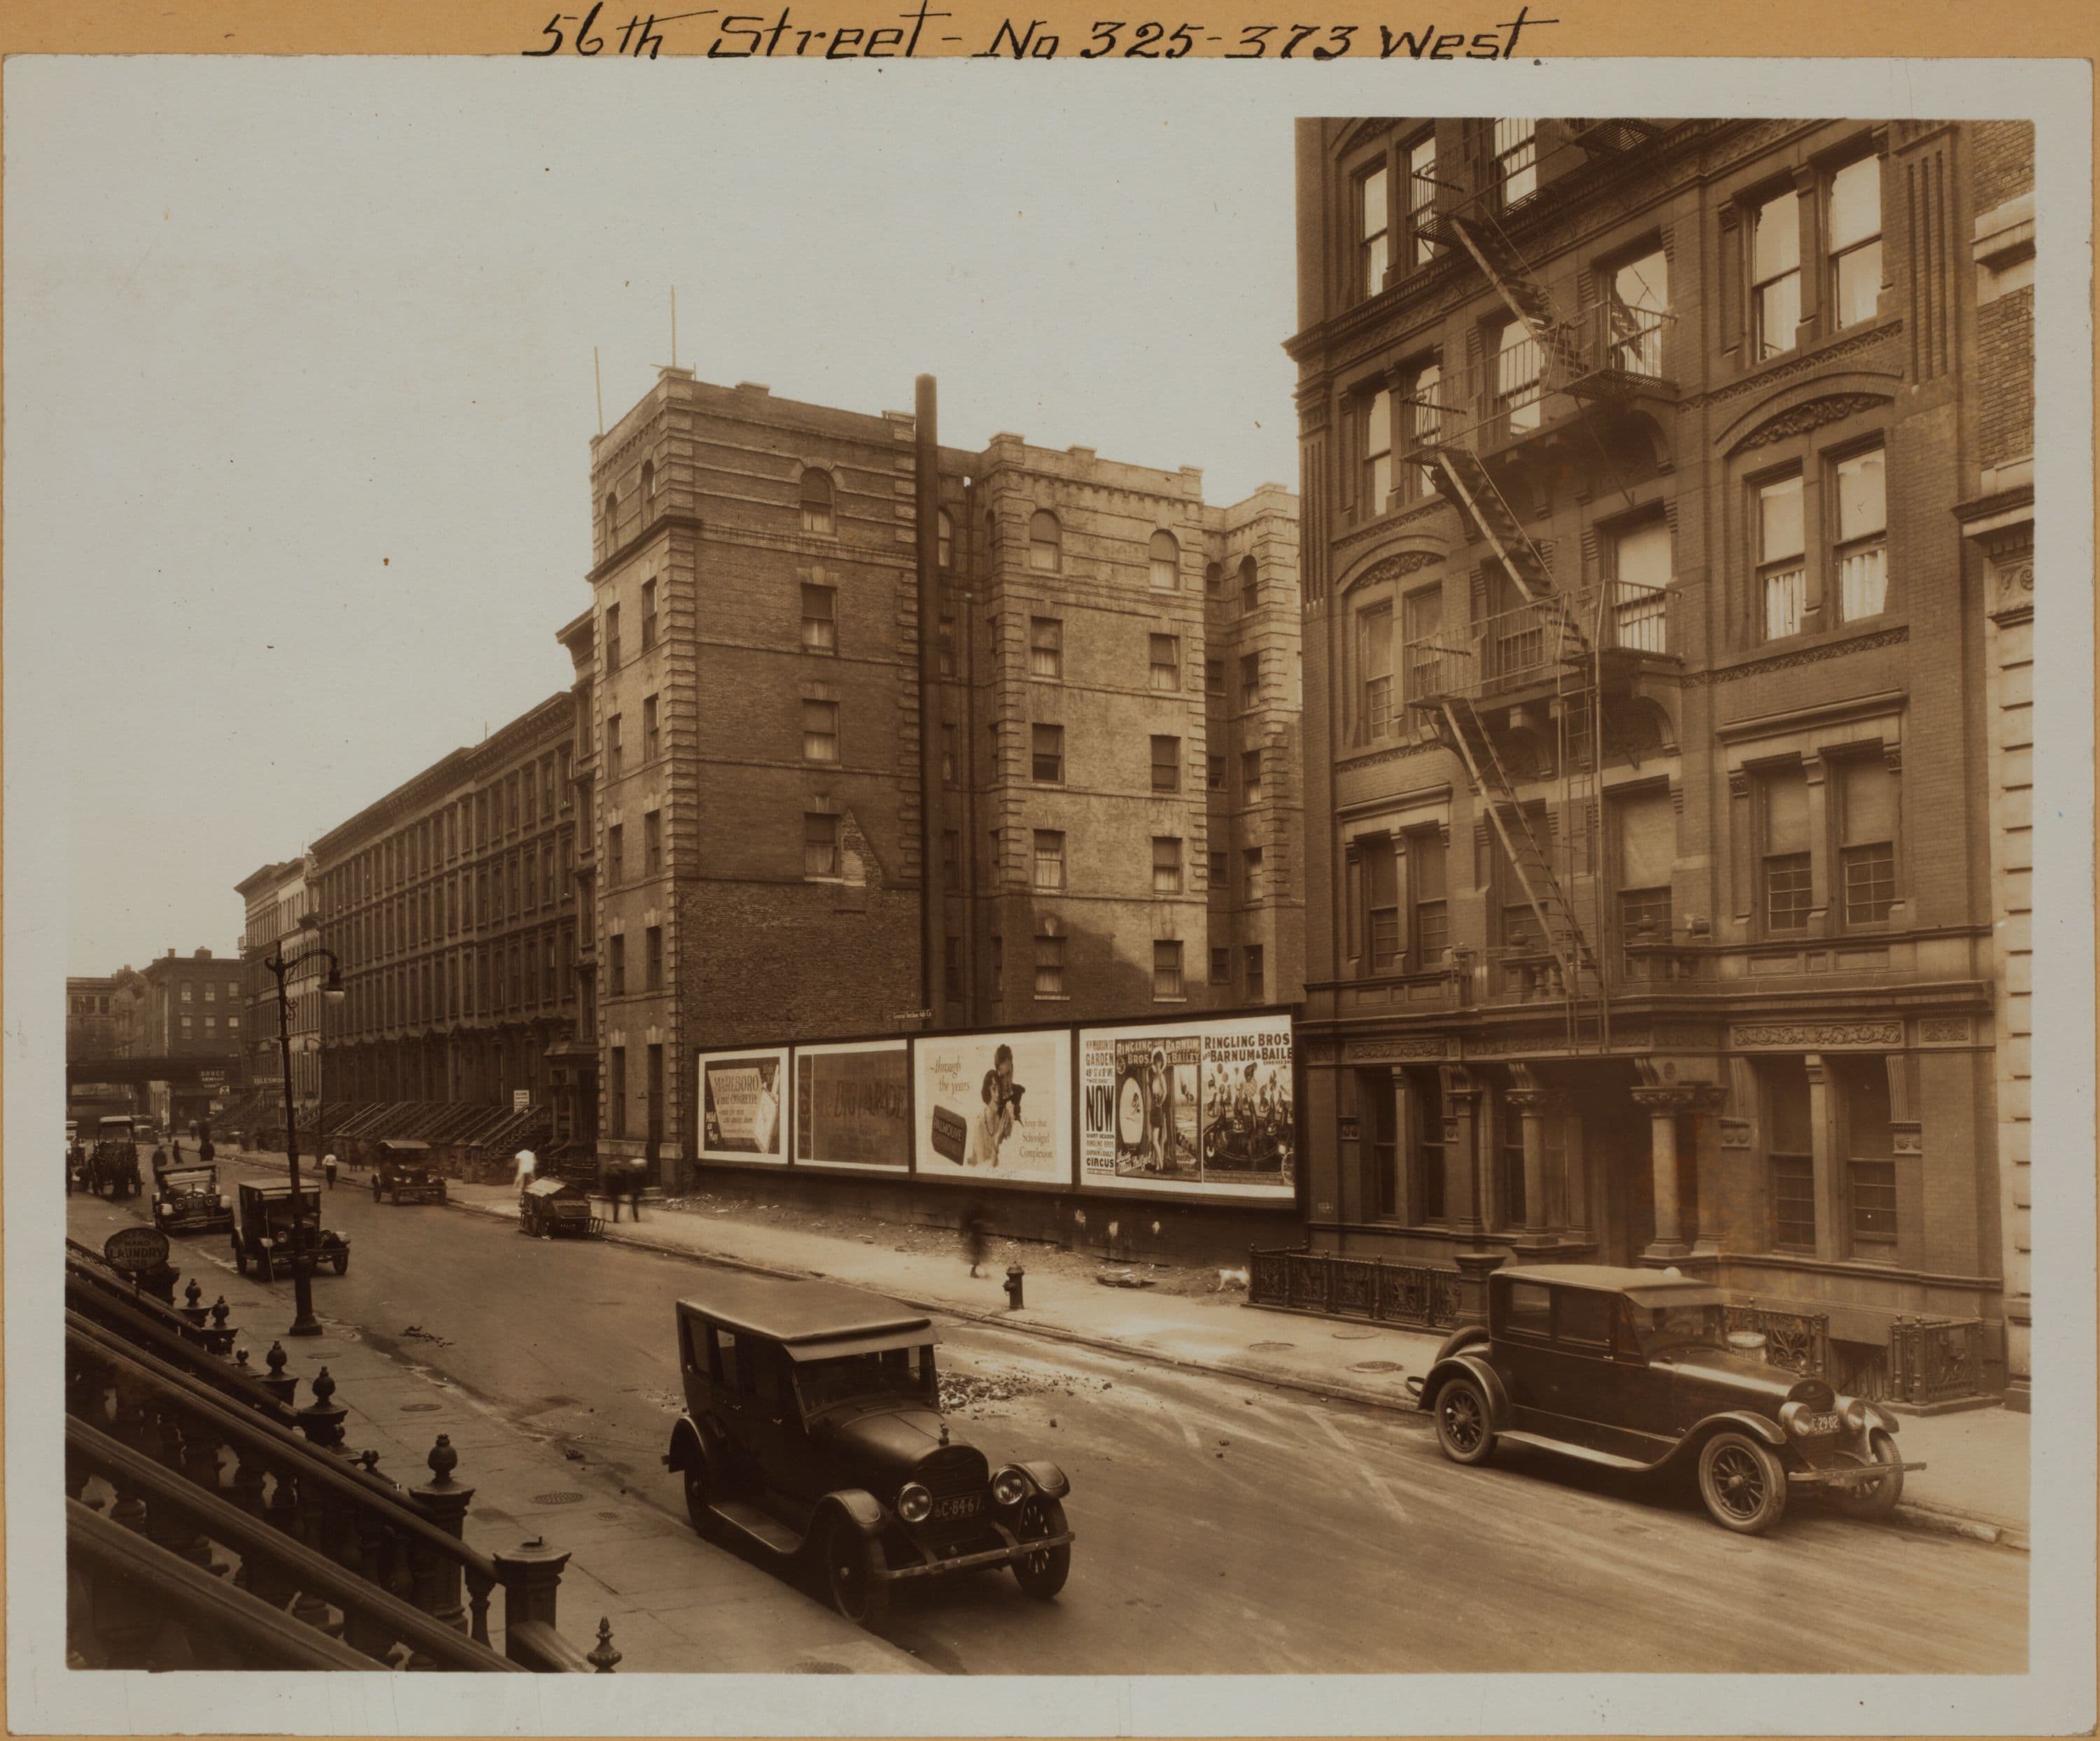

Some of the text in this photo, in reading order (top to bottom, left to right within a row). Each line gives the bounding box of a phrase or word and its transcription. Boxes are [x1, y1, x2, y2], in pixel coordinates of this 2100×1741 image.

[521, 1, 718, 59] 56th
[707, 0, 952, 58] Street
[972, 18, 1059, 59] No
[1116, 1041, 1153, 1057] RINGLING
[1166, 1038, 1199, 1053] BARNUM
[1204, 1033, 1290, 1050] RINGLING BROS
[1086, 1052, 1114, 1066] GARDEN
[1127, 1054, 1150, 1064] BROS
[1171, 1052, 1199, 1064] BAILEY
[1211, 1049, 1255, 1063] BARNUM
[714, 1074, 759, 1092] MARLBORO
[939, 1076, 971, 1096] the years
[1086, 1085, 1114, 1132] NOW
[933, 1115, 964, 1143] PALMOLIVE
[1037, 1117, 1048, 1127] that
[1022, 1132, 1050, 1147] Schoolgirl
[1019, 1146, 1054, 1161] Complexion
[1086, 1157, 1115, 1168] CIRCUS
[109, 1248, 164, 1259] LAUNDRY
